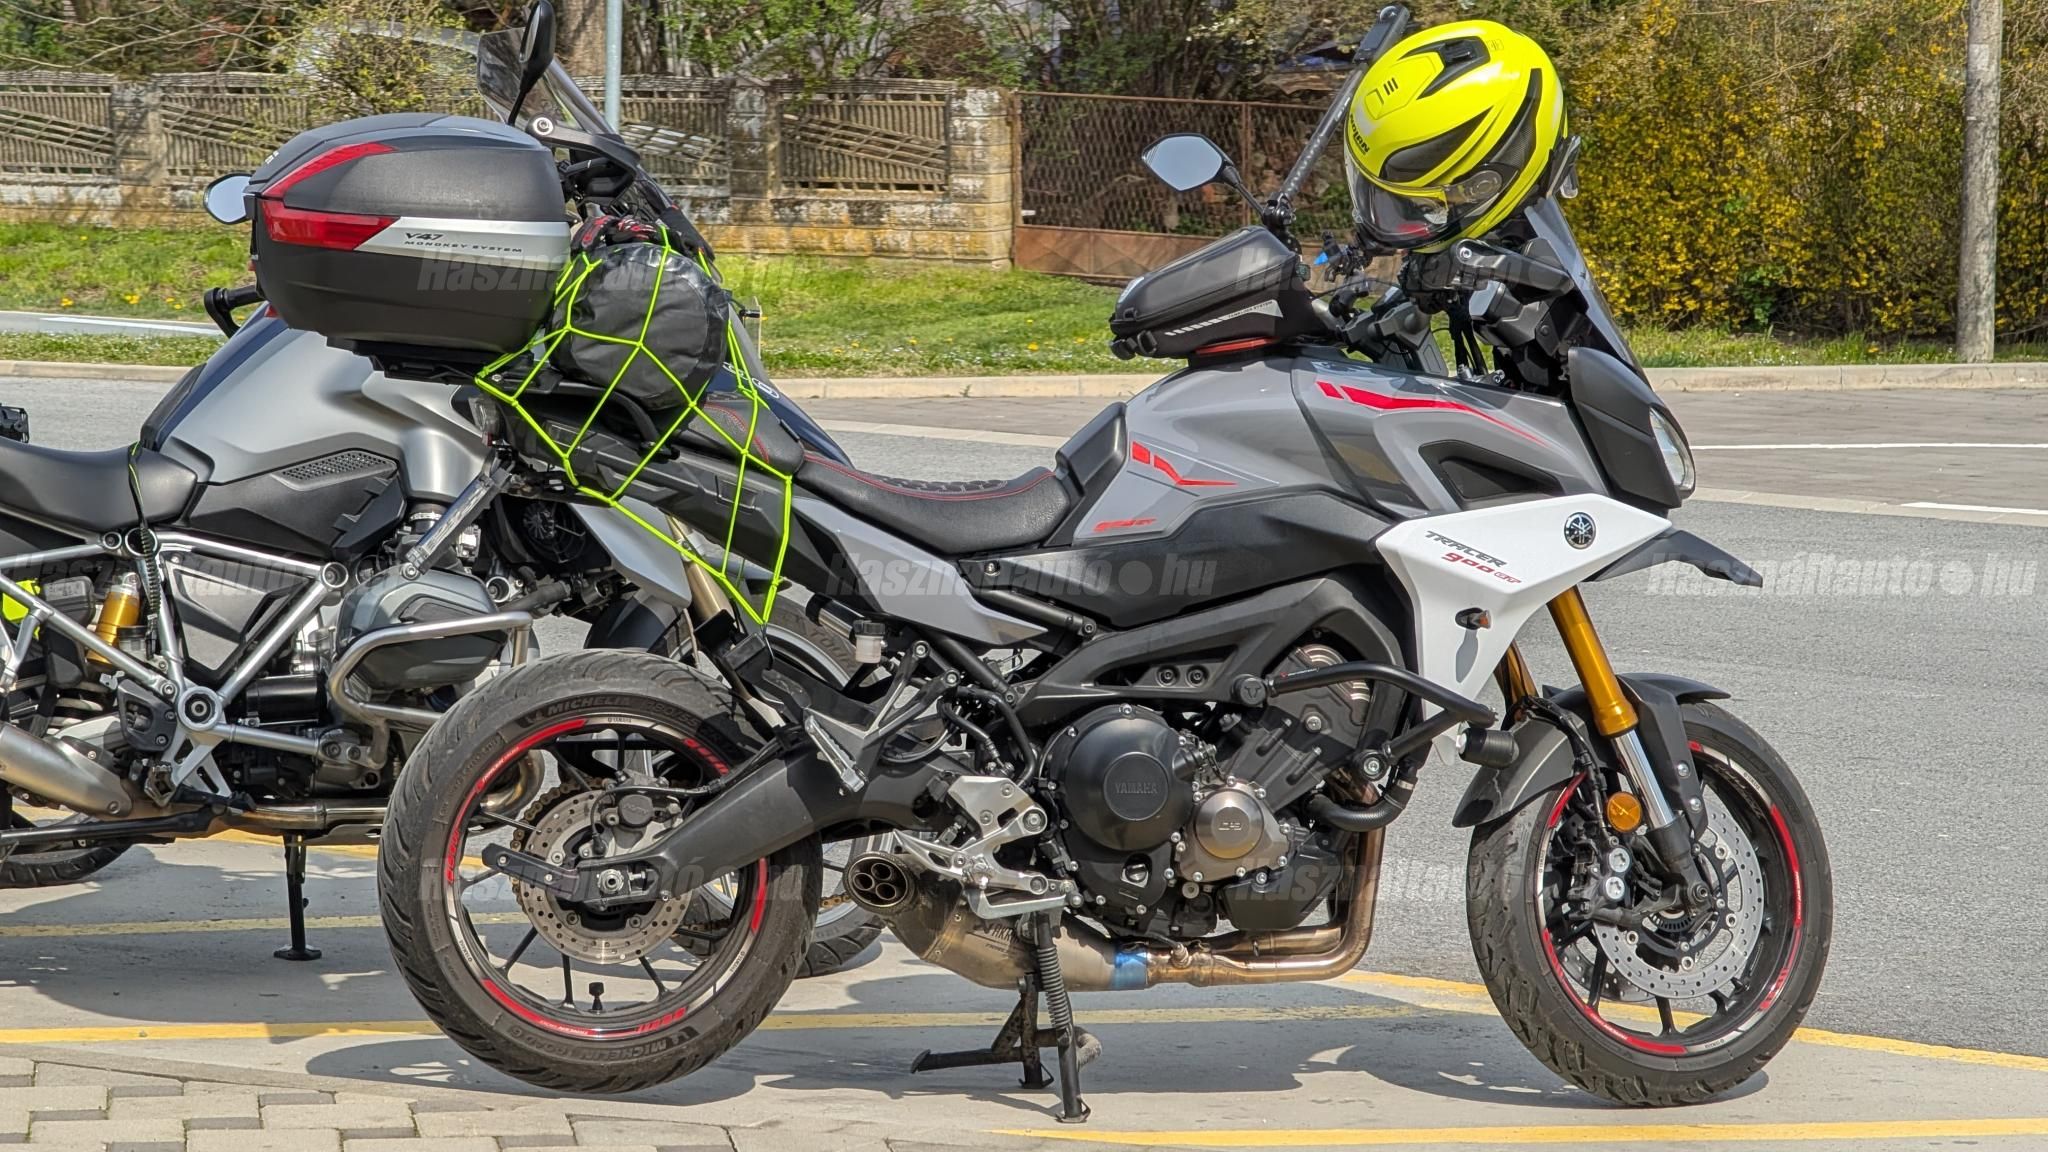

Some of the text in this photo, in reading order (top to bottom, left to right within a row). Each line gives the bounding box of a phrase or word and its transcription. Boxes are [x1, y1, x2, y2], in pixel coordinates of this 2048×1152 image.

[405, 232, 444, 241] V47
[404, 240, 522, 253] MONOKEY SYSTEM
[1425, 530, 1507, 568] TRACER
[1441, 552, 1495, 574] 900
[547, 694, 632, 717] MICHELIN
[1114, 782, 1158, 794] YAMAHA
